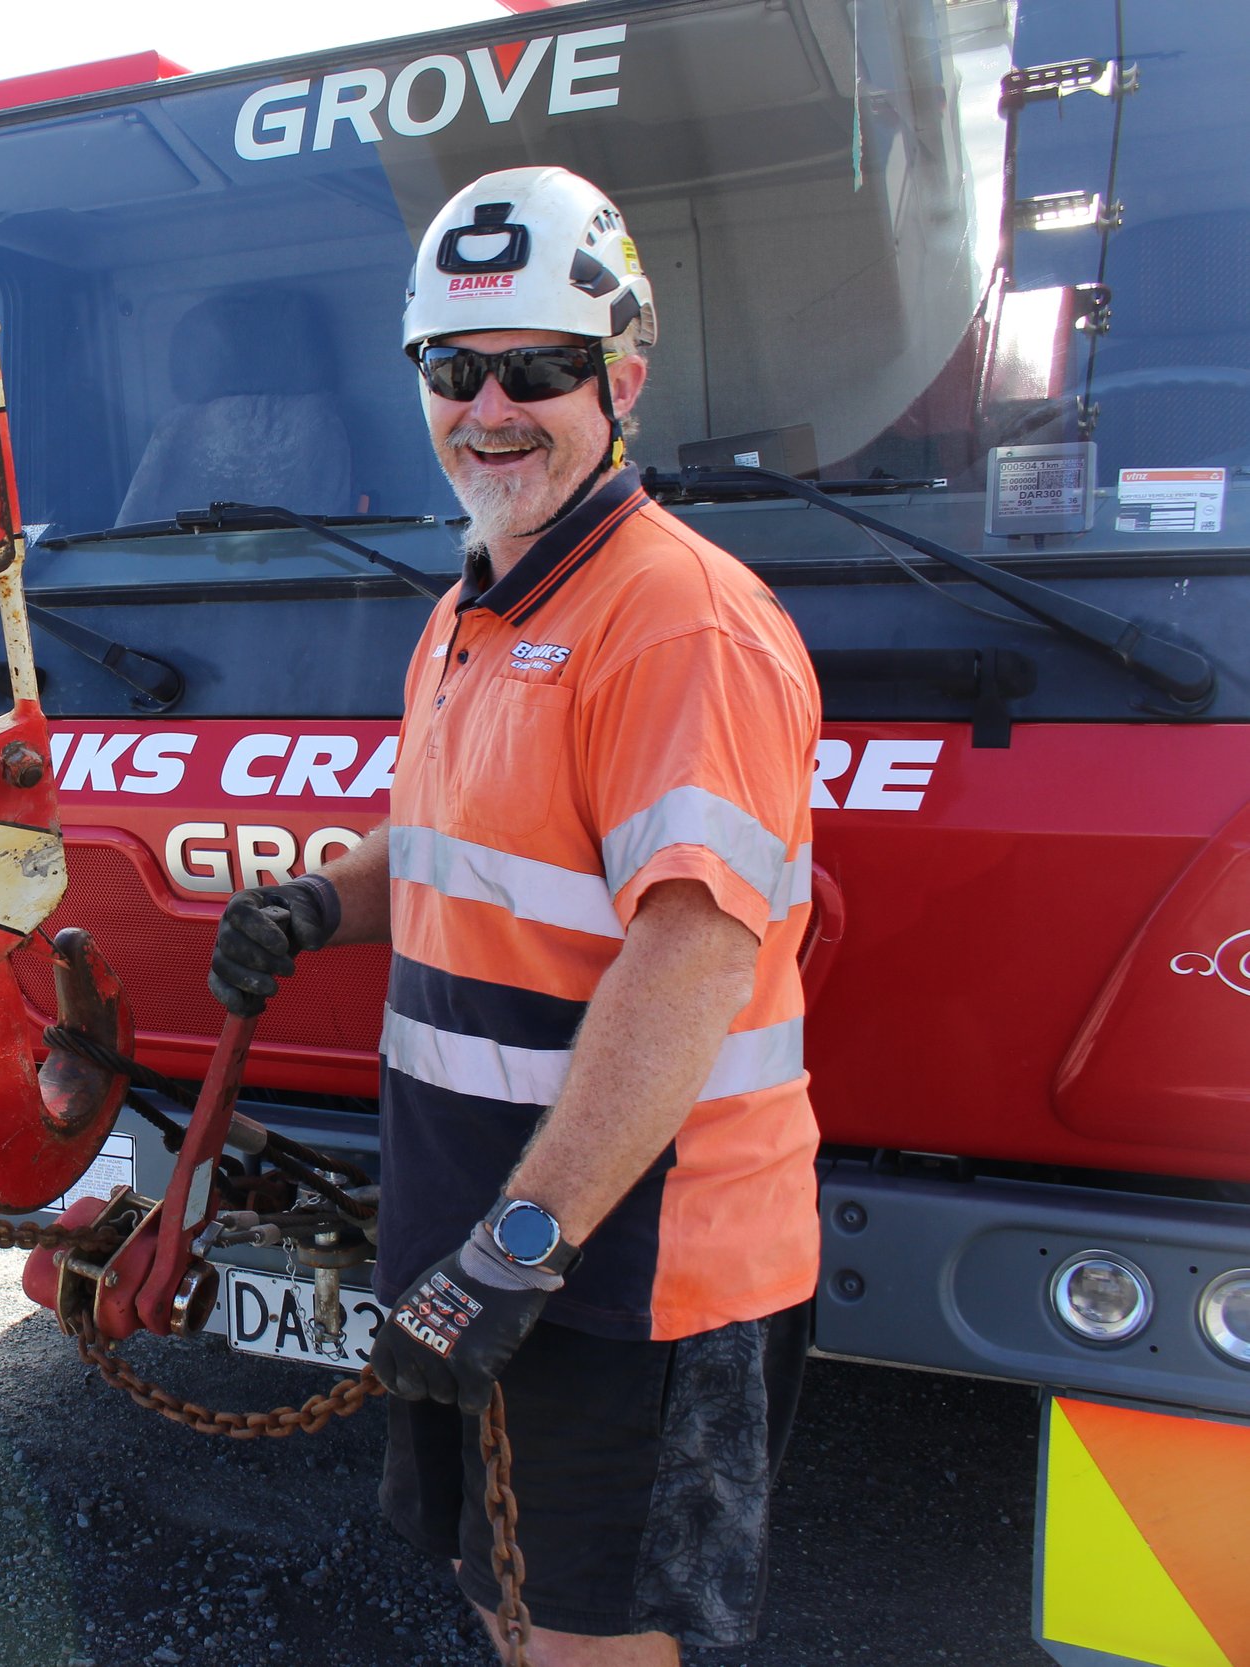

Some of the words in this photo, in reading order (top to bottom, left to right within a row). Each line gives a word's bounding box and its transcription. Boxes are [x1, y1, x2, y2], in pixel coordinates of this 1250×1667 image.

[234, 24, 627, 160] GROVE
[449, 275, 513, 291] BANKS
[1126, 472, 1148, 481] vtnz
[1019, 490, 1063, 499] DAR300
[511, 641, 571, 663] BANKS
[531, 660, 553, 672] Hire
[466, 1299, 479, 1311] 2XL
[396, 1309, 451, 1355] DUTY
